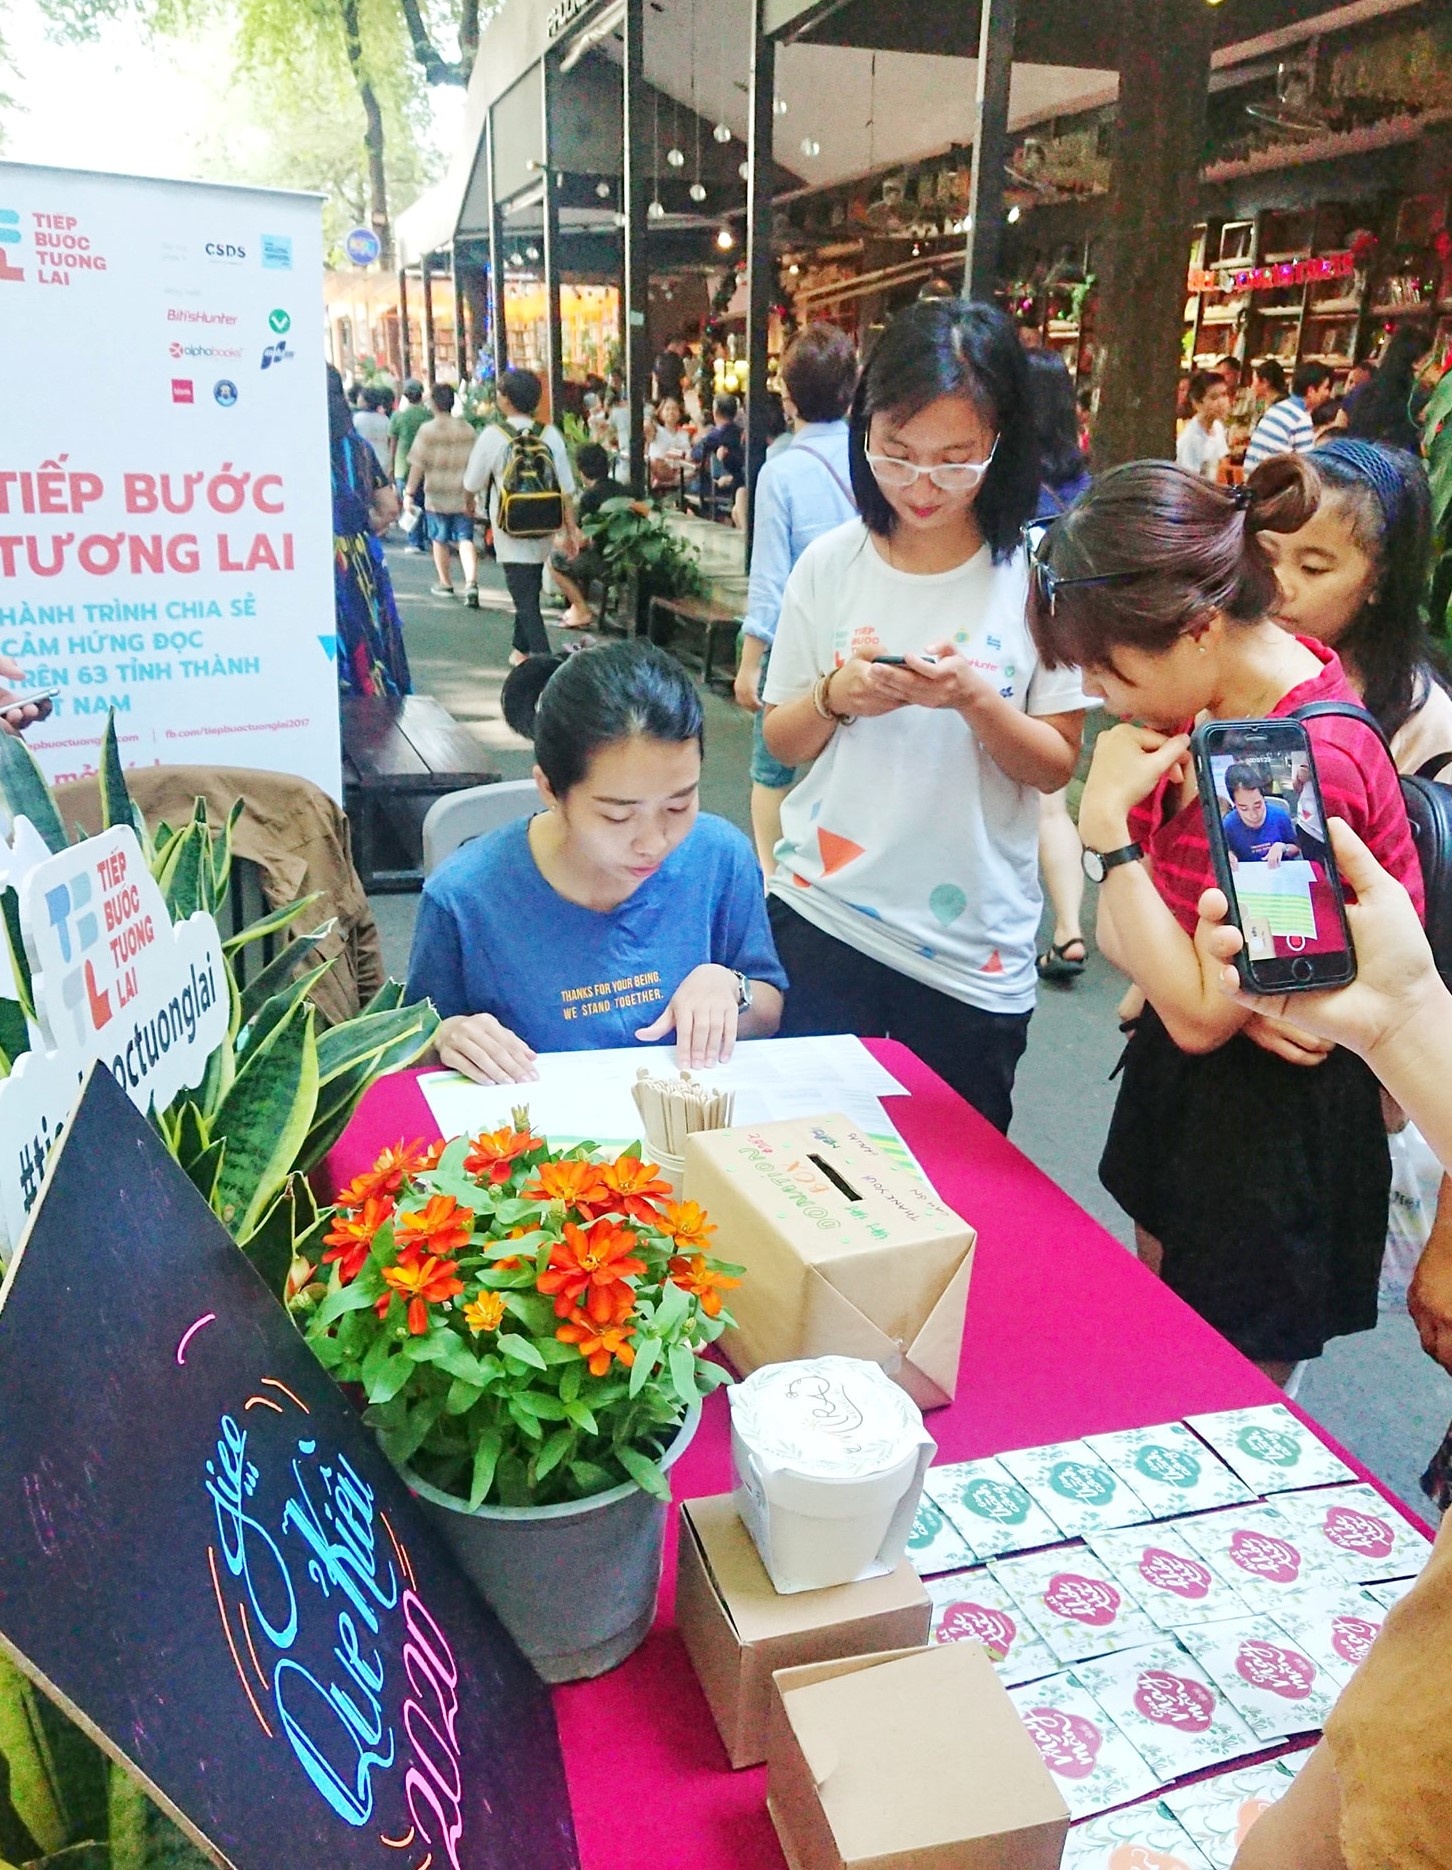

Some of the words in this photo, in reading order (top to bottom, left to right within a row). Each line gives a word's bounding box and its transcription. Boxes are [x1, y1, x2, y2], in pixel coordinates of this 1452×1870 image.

[32, 212, 77, 230] TIEP
[34, 232, 90, 251] BUOC
[205, 243, 246, 258] CSDS
[36, 250, 107, 271] TUONG
[38, 269, 70, 286] LAI
[0, 454, 104, 514] TIẾP
[123, 462, 285, 514] BƯỚC
[0, 532, 200, 577] TƯƠNG
[217, 533, 295, 571] LAI
[0, 601, 75, 626] HÀNH
[83, 599, 158, 623] TRÌNH
[165, 599, 222, 620] CHIA
[230, 592, 256, 617] SẺ
[0, 631, 59, 658] CẢM
[68, 629, 145, 654] HỨNG
[152, 631, 203, 654] ĐỌC
[77, 665, 108, 685] 63
[116, 657, 172, 683] TỈNH
[179, 654, 260, 678] THÀNH
[73, 694, 131, 716] NAM
[116, 966, 138, 1009] LAI
[561, 986, 594, 1003] THANKS
[594, 984, 611, 996] FOR
[612, 978, 633, 992] YOUR
[563, 1007, 578, 1020] WE
[582, 1001, 611, 1017] STAND
[401, 1589, 461, 1870] 2020
